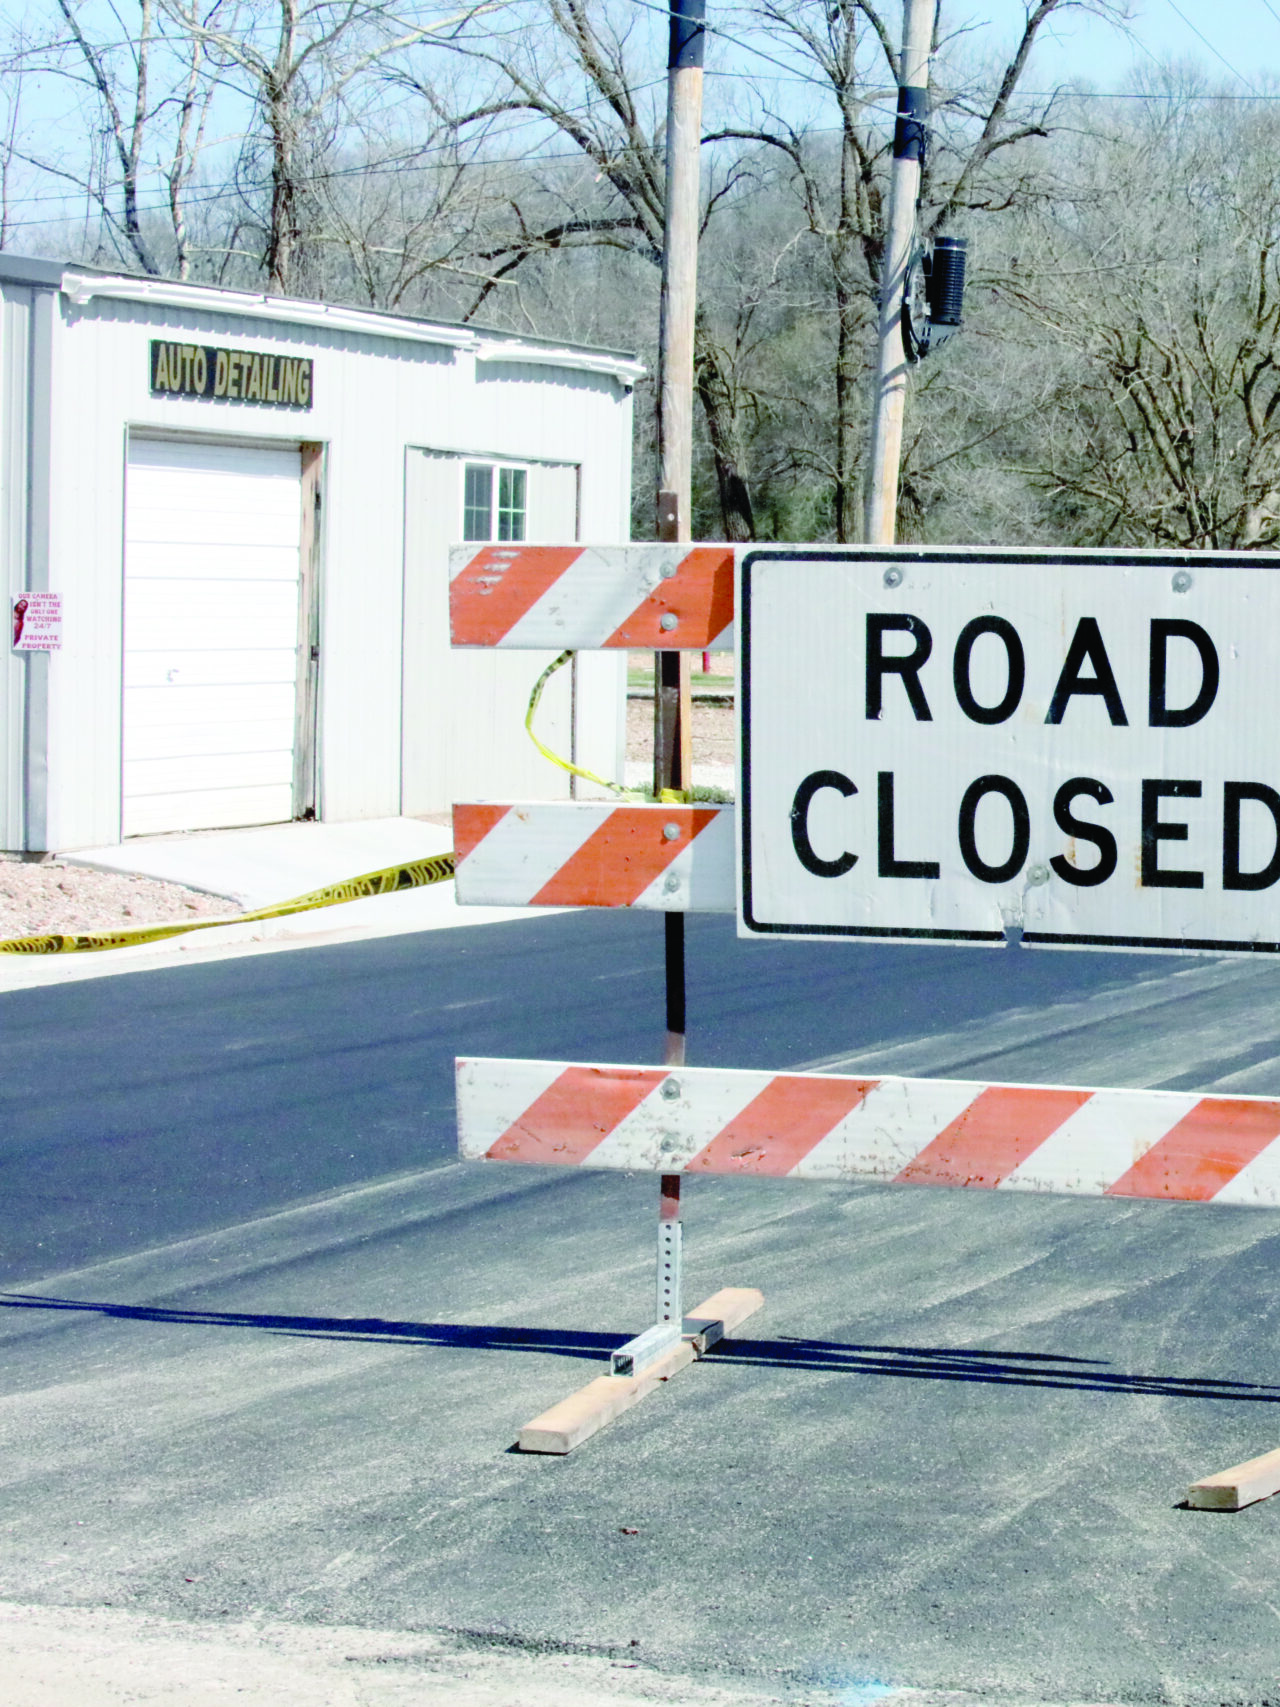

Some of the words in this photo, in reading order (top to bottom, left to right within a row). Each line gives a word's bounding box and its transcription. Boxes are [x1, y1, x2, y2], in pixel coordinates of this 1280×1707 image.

[155, 343, 207, 394] AUTO
[213, 350, 311, 405] DETAILING
[865, 612, 1220, 729] ROAD
